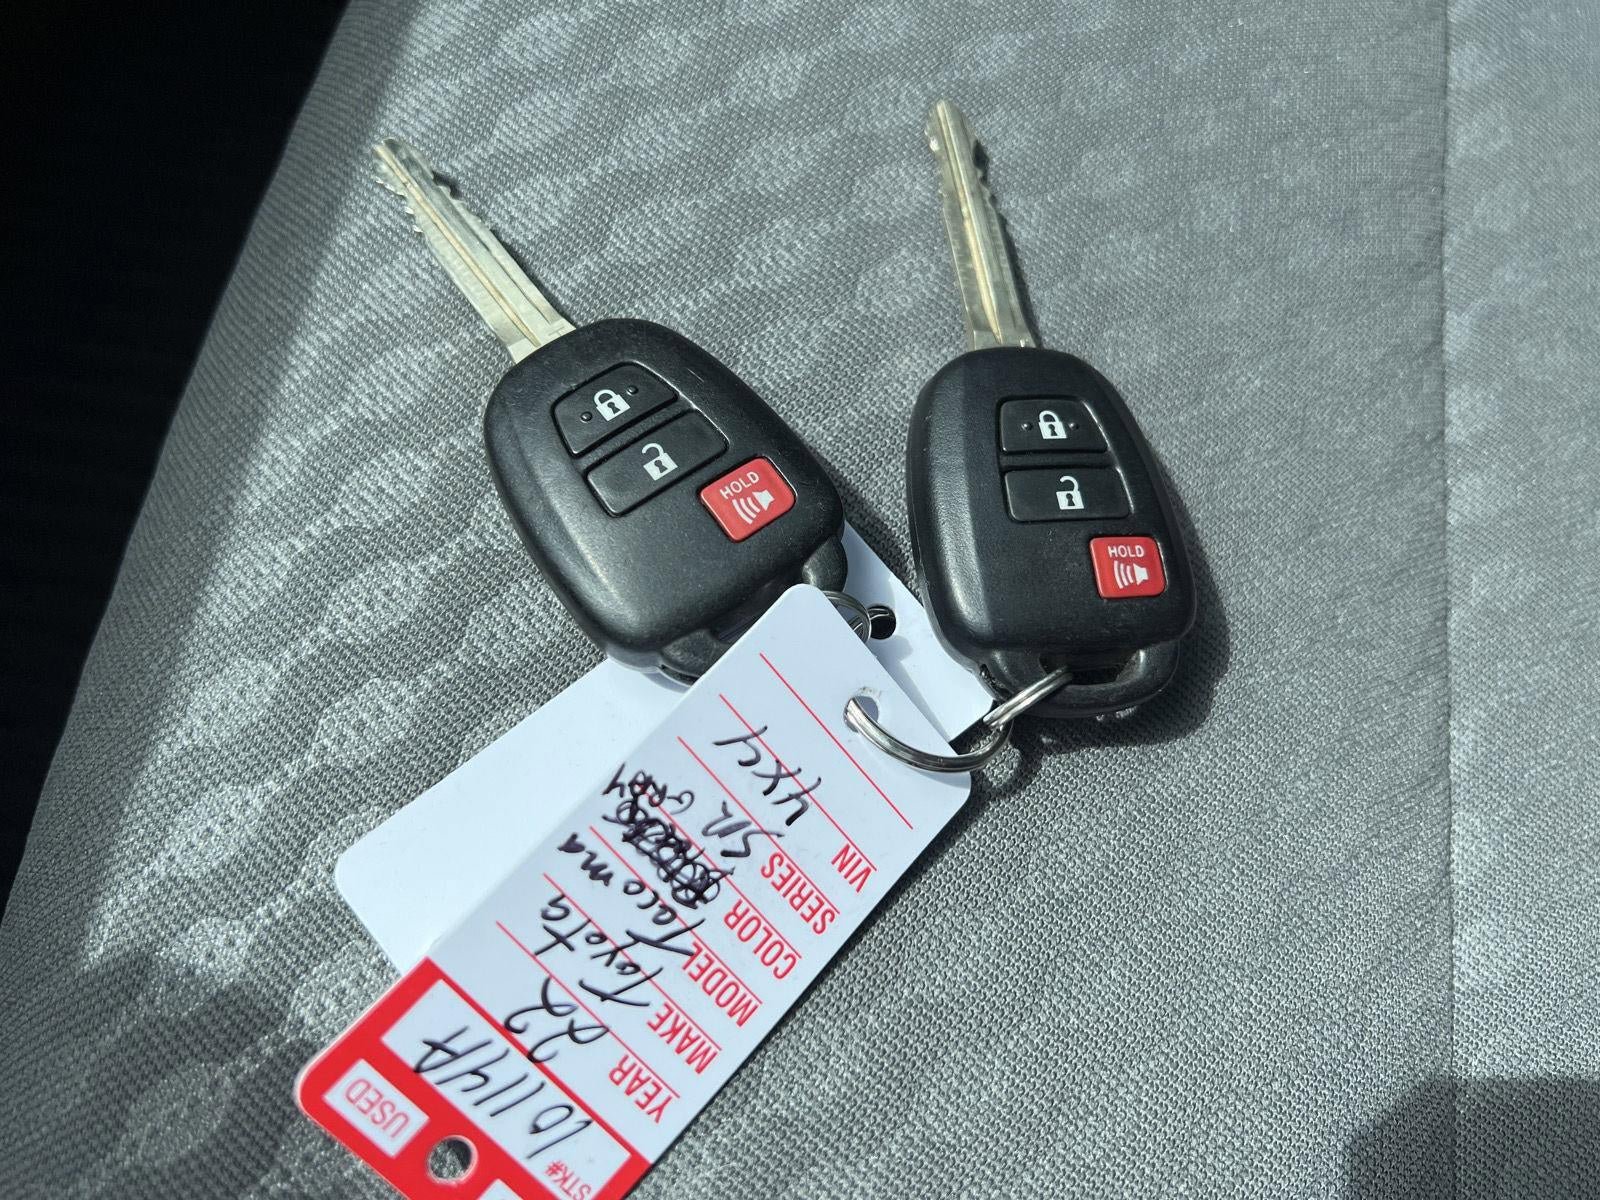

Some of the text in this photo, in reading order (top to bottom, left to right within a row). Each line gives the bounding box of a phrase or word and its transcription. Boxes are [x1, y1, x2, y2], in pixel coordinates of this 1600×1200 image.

[719, 470, 761, 501] HOLD
[1107, 544, 1145, 559] HOLD
[557, 832, 706, 956] Tacoma
[760, 852, 836, 935] SERIES
[831, 843, 873, 893] VIN
[533, 893, 663, 1007] Toyota
[723, 897, 798, 980] COLOR
[504, 976, 610, 1064] 22
[681, 940, 760, 1027] MODEL
[647, 1001, 720, 1075] MAKE
[344, 1077, 411, 1139] USED
[413, 1025, 592, 1160] 10114A
[609, 1055, 673, 1123] YEAR
[544, 1160, 592, 1200] STK#
